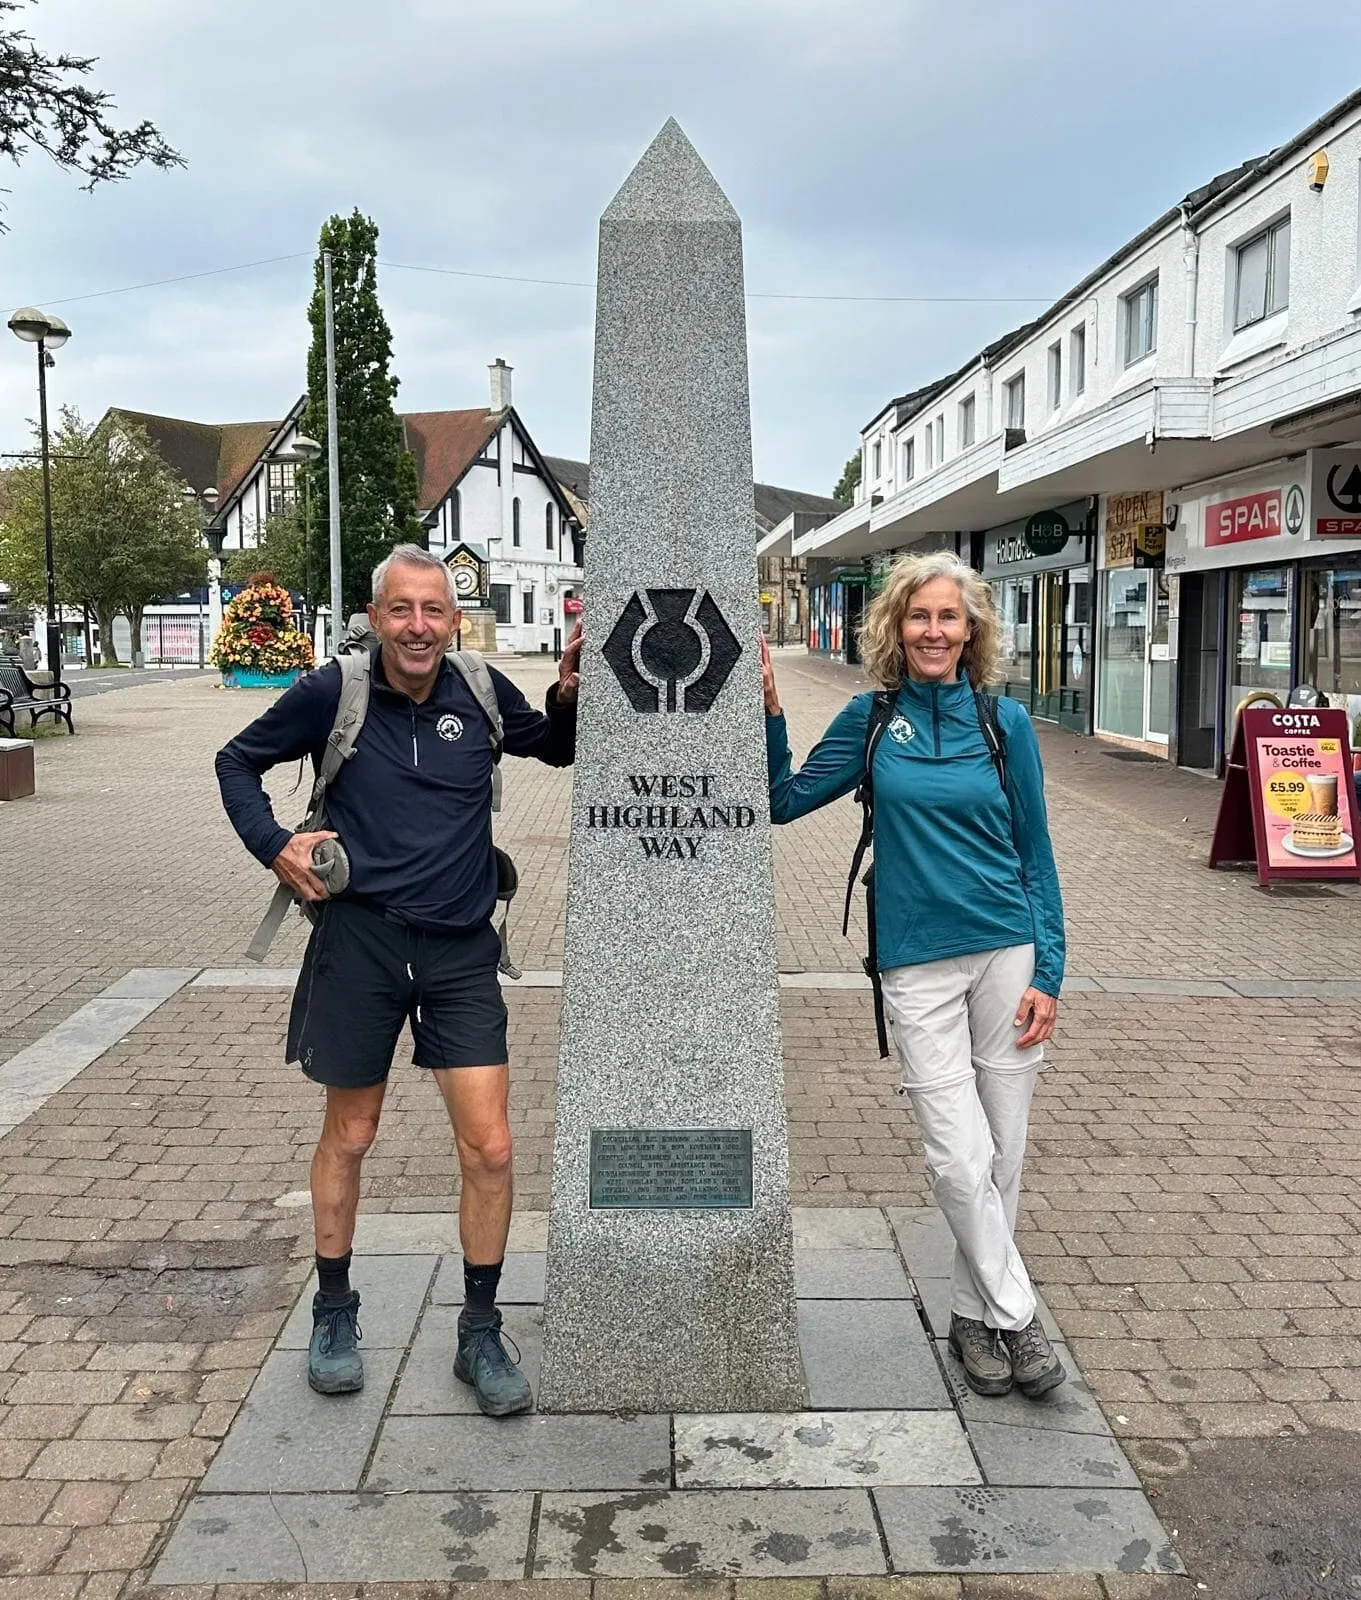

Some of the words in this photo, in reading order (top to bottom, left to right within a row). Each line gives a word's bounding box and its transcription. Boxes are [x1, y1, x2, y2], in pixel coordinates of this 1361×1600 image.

[1116, 492, 1149, 526] OPEN
[1219, 498, 1280, 537] SPAR
[1272, 714, 1321, 728] COSTA
[1262, 744, 1315, 757] Toastie
[1281, 757, 1322, 768] Coffee
[628, 774, 717, 798] WEST
[1270, 782, 1305, 793] £5.99
[587, 805, 756, 829] HIGHLAND
[638, 836, 705, 859] WAY
